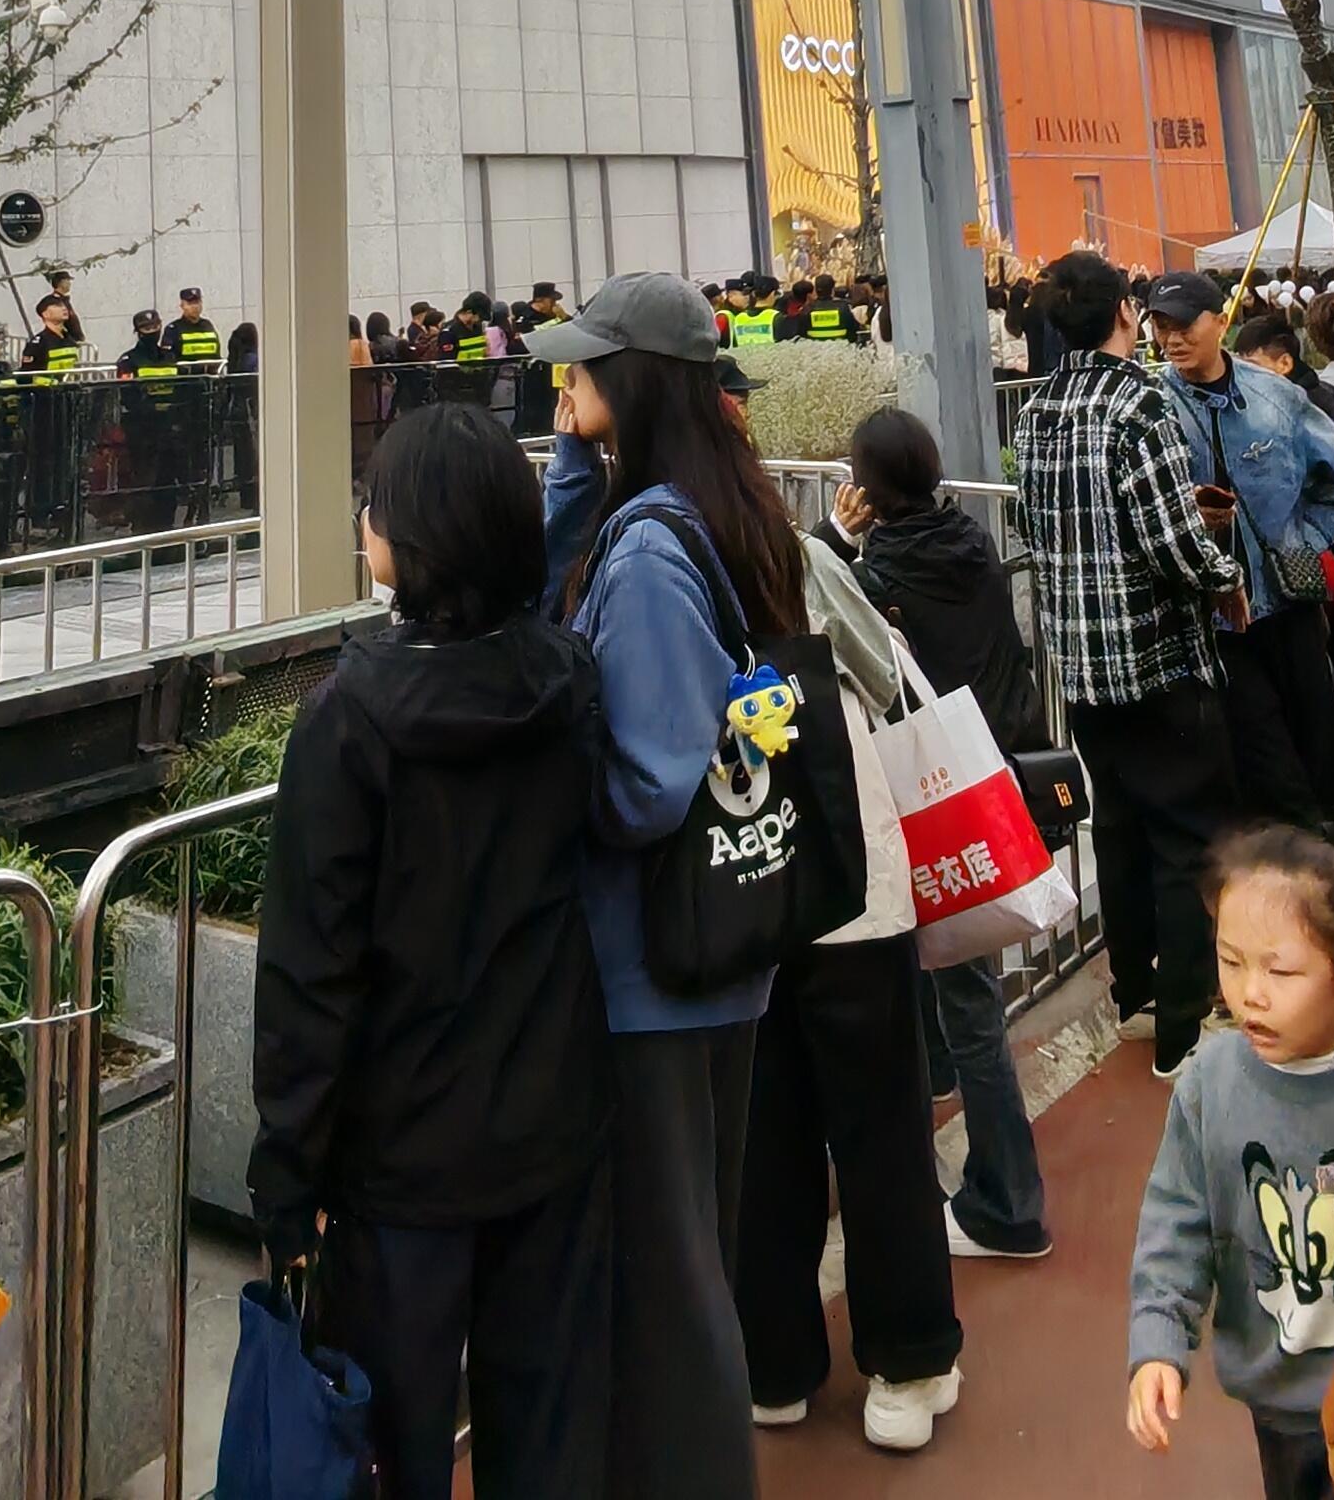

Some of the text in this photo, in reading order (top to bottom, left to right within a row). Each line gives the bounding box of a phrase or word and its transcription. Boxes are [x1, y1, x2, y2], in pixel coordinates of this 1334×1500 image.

[707, 796, 797, 866] Aape
[912, 840, 1001, 906] 号衣库
